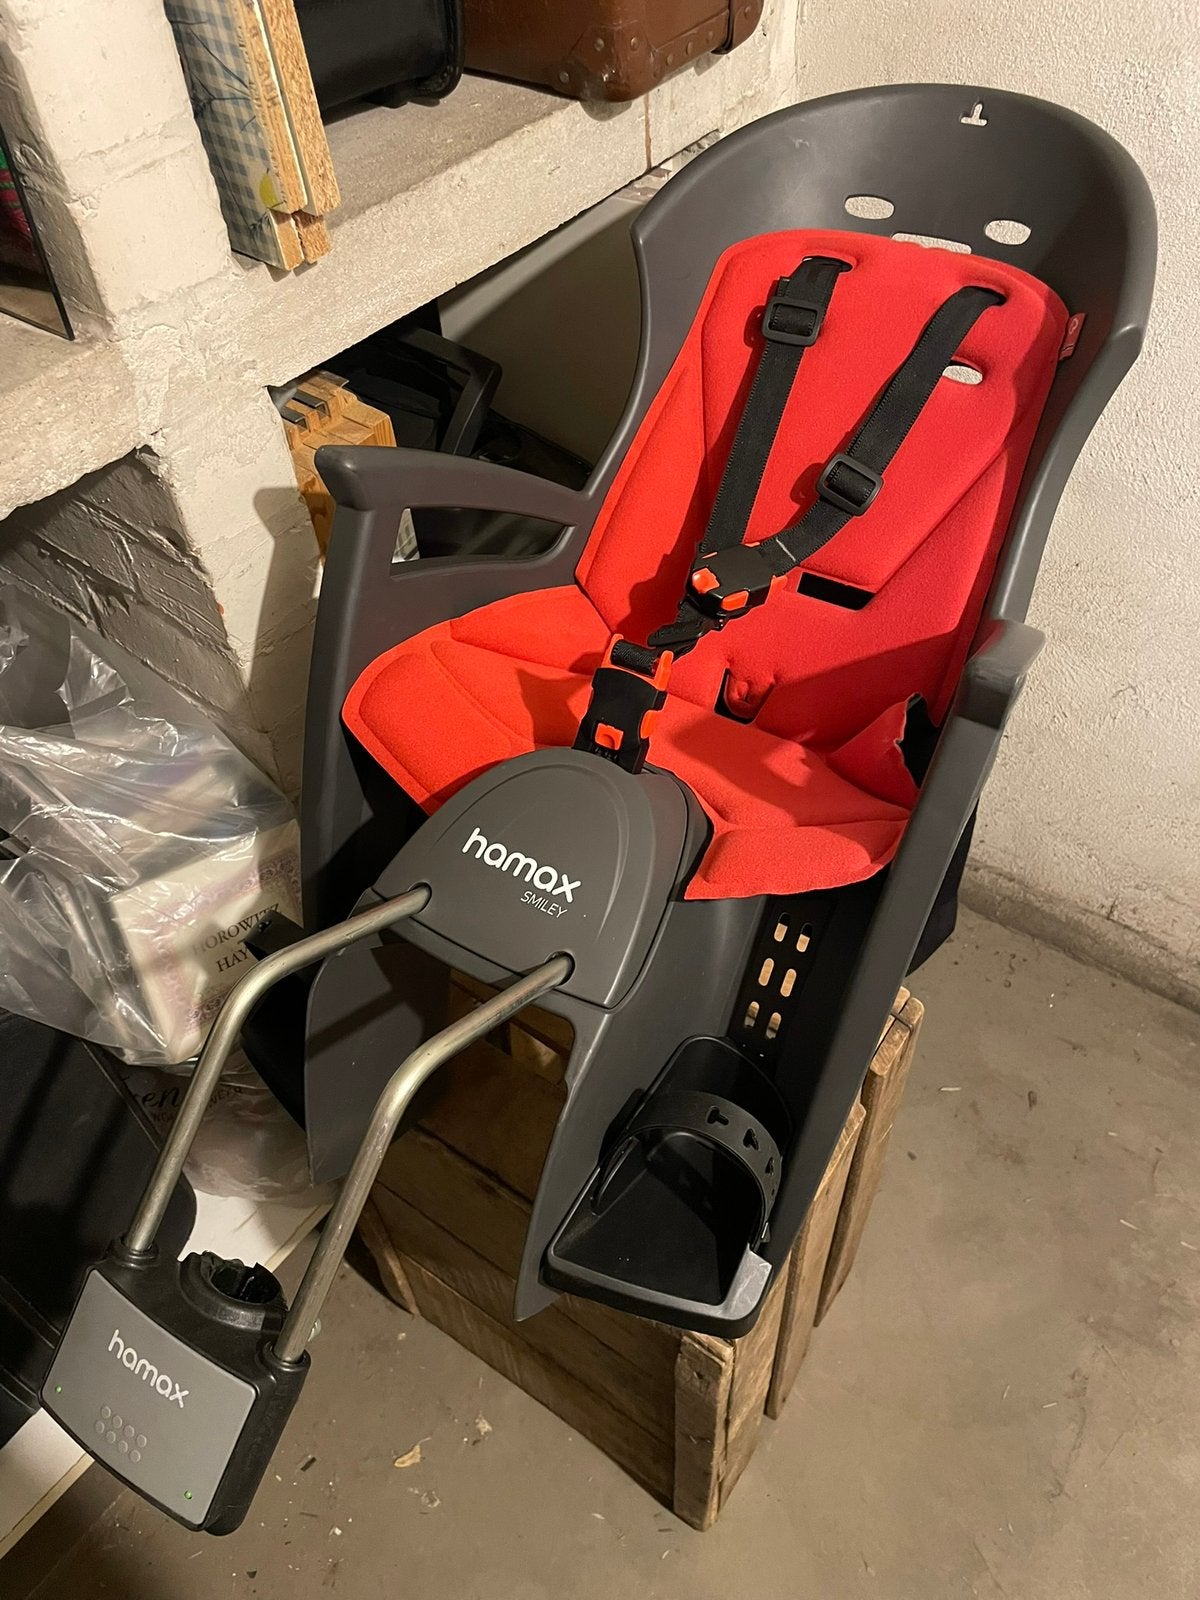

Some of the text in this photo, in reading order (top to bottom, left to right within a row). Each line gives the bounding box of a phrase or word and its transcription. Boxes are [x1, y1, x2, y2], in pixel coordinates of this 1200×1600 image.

[462, 827, 581, 903] hamax
[520, 890, 568, 918] SMILEY
[107, 1329, 190, 1408] hamax
